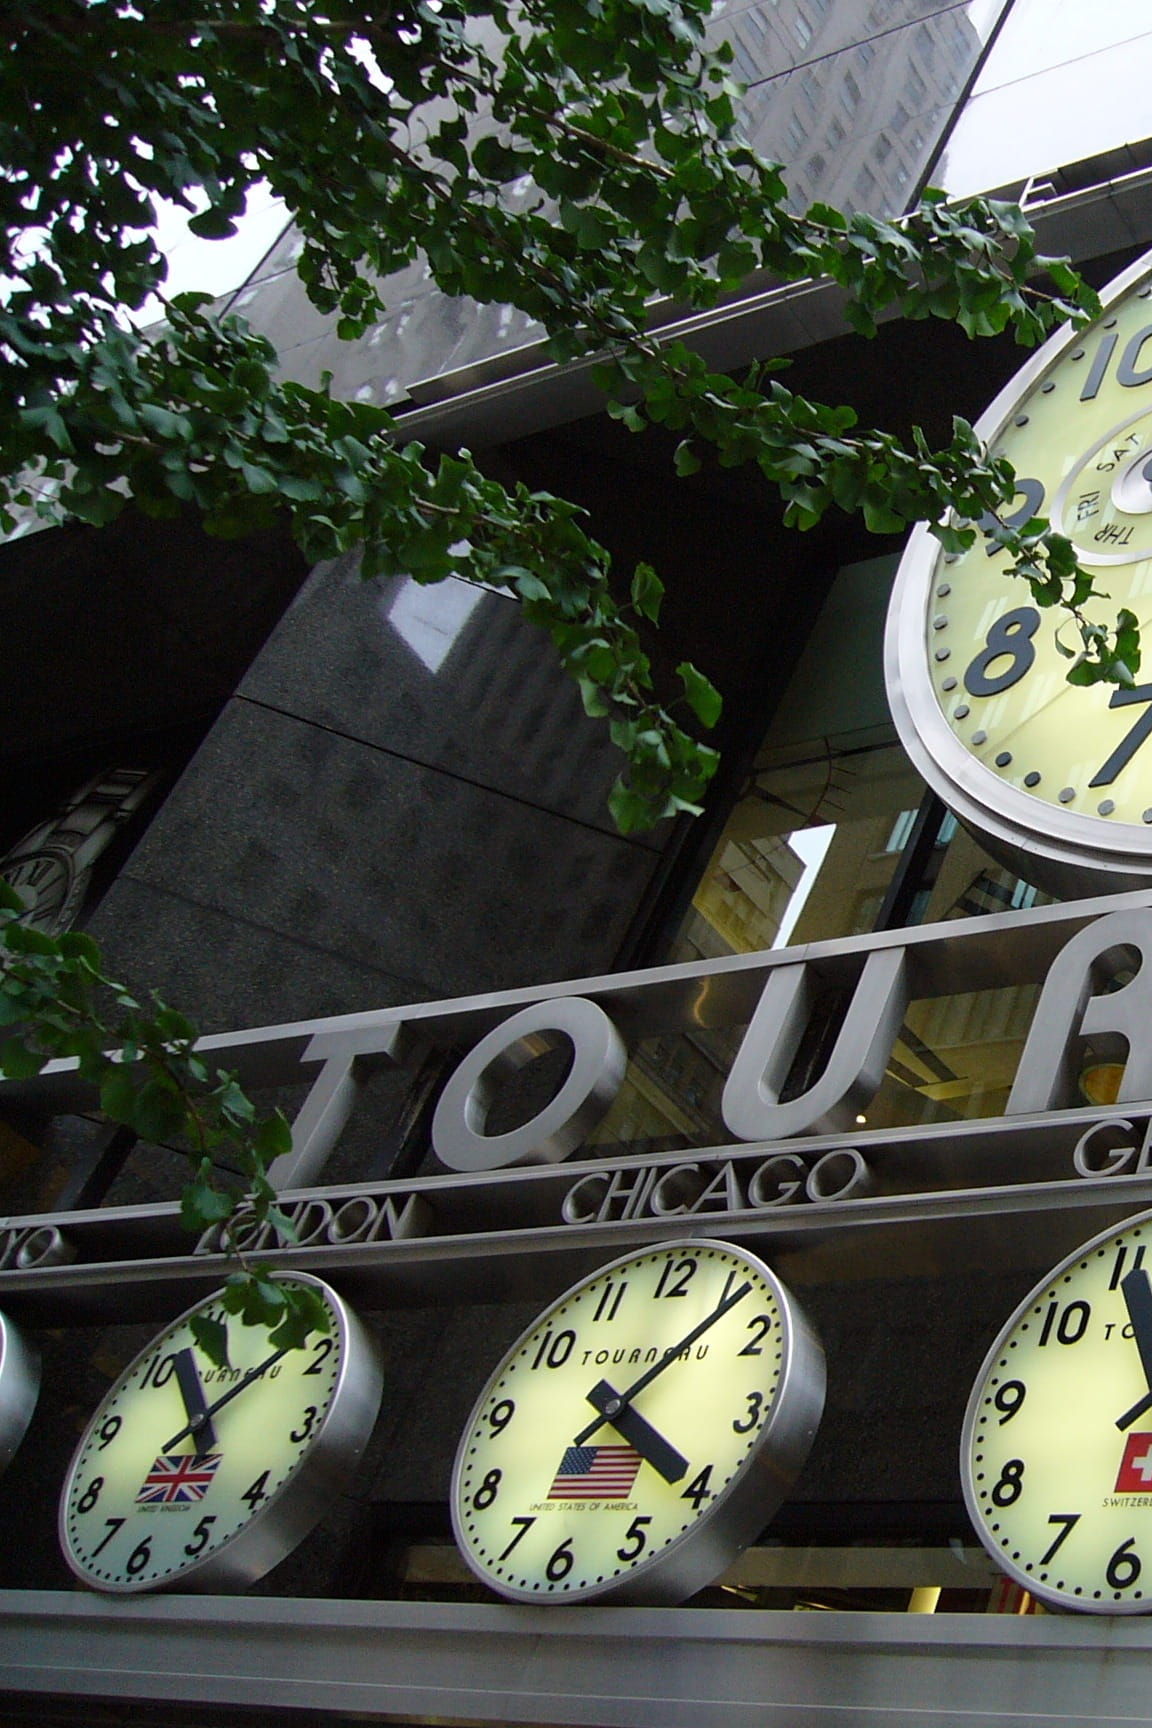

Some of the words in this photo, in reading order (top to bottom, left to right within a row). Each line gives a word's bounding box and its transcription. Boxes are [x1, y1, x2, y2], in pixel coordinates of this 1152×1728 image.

[1096, 432, 1140, 473] SAT
[1077, 490, 1100, 522] FRI
[1093, 522, 1135, 546] THR
[964, 606, 1041, 697] 8
[561, 1148, 868, 1225] CHICAGO
[653, 1258, 697, 1299] 12
[719, 1270, 736, 1307] 1
[593, 1281, 627, 1321] 11
[738, 1315, 771, 1356] 2
[1039, 1300, 1091, 1347] 10
[302, 1339, 333, 1375] 2
[531, 1329, 576, 1370] 10
[139, 1354, 175, 1391] 10
[489, 1399, 515, 1439] 9
[733, 1391, 764, 1434] 3
[993, 1379, 1026, 1425] 9
[98, 1416, 123, 1451] 9
[291, 1406, 317, 1444] 3
[77, 1477, 104, 1515] 8
[241, 1470, 271, 1509] 4
[472, 1469, 502, 1511] 8
[681, 1464, 714, 1510] 4
[991, 1459, 1025, 1507] 8
[91, 1518, 127, 1557] 7
[127, 1535, 152, 1575] 6
[184, 1516, 216, 1555] 5
[499, 1516, 537, 1562] 7
[617, 1516, 652, 1562] 5
[1040, 1513, 1082, 1565] 7
[545, 1538, 573, 1582] 6
[1106, 1537, 1142, 1589] 6
